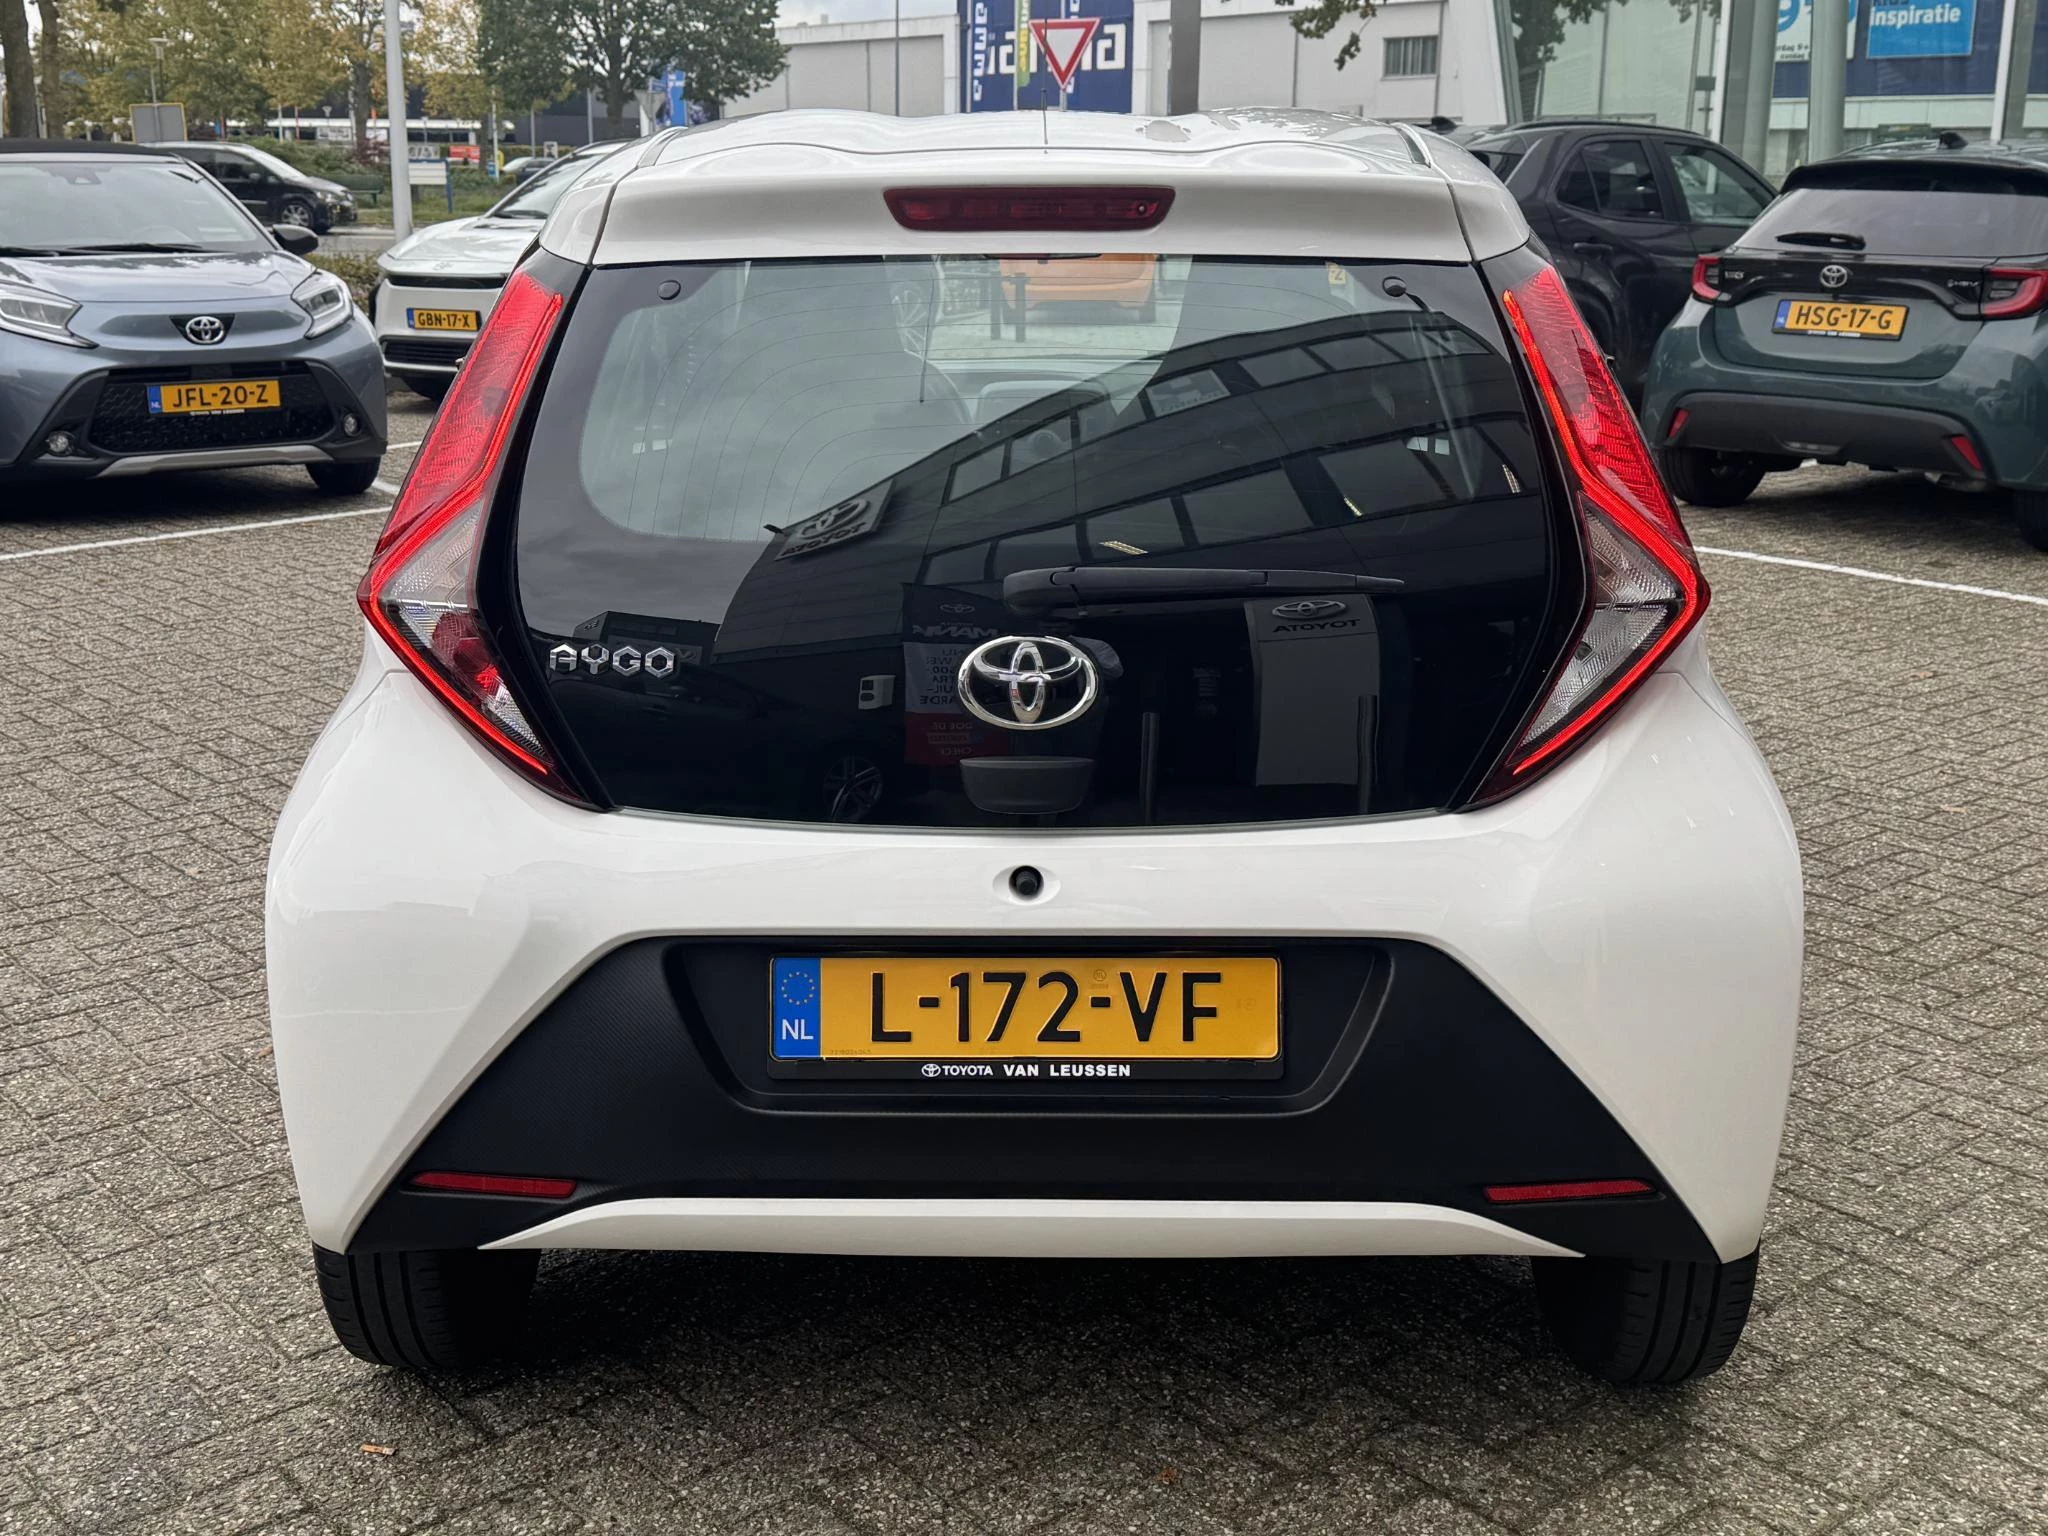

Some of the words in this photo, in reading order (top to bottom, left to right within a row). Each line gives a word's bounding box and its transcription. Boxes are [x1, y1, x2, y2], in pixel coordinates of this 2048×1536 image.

[1870, 3, 1961, 30] inspiratie
[973, 2, 988, 101] amma
[418, 312, 470, 328] GBN-17-X
[1795, 305, 1893, 329] HSG-17-G
[173, 384, 268, 408] JFL-20-Z
[549, 643, 675, 678] AYGO
[871, 971, 1222, 1043] L-172-VF
[782, 1019, 814, 1040] NL
[942, 1065, 993, 1076] TOYOTA
[1003, 1064, 1039, 1076] VAN
[1050, 1064, 1131, 1076] LEUSSEN
